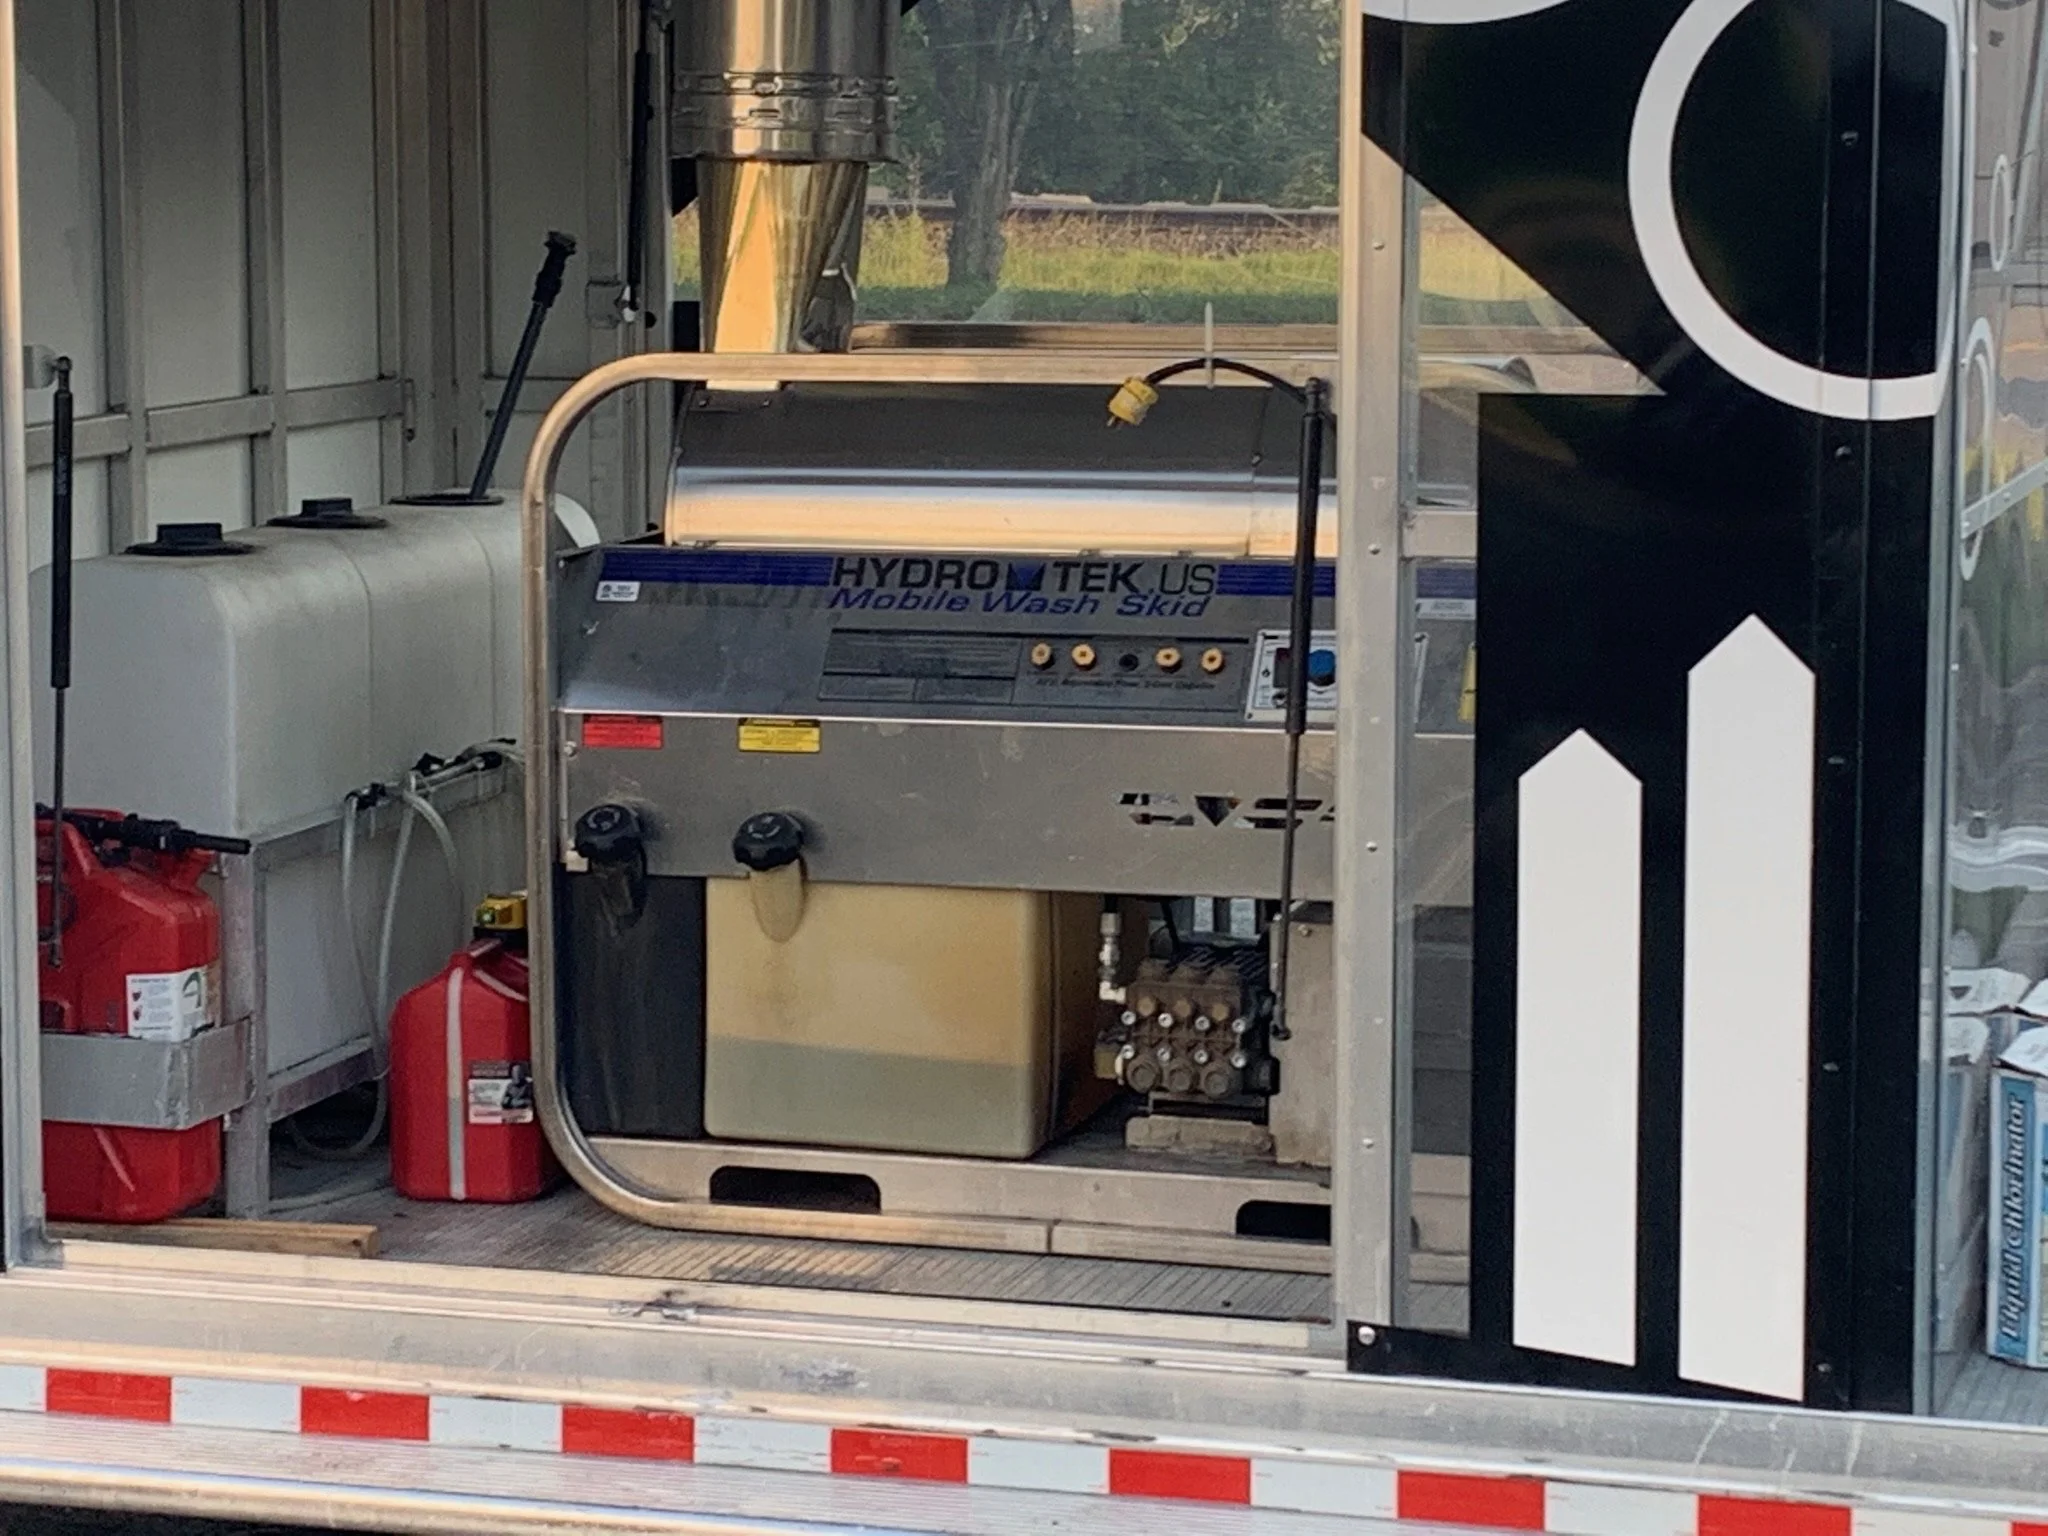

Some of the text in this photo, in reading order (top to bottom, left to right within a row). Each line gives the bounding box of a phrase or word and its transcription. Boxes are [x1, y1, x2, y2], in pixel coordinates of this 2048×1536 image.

[833, 557, 1000, 590] HYDRO
[828, 586, 1213, 618] Mobile Wash Skid
